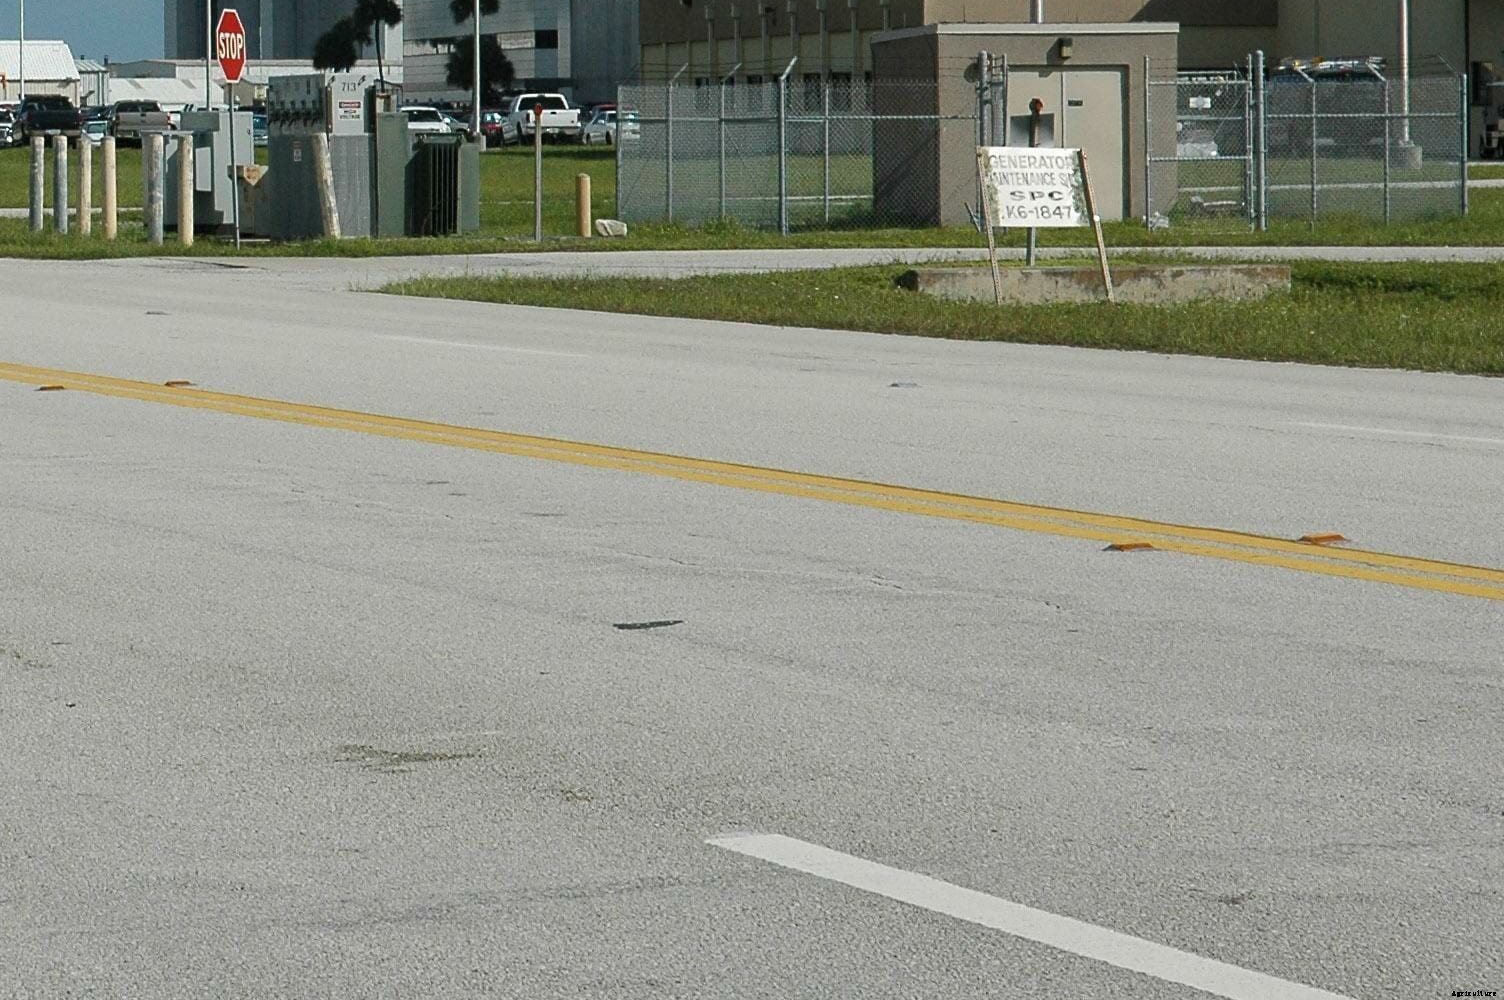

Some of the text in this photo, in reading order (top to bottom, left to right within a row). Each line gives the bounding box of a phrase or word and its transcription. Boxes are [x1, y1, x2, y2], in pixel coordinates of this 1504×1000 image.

[219, 32, 243, 60] STOP
[341, 81, 356, 92] 713
[988, 154, 1074, 169] GENERATOR
[1009, 190, 1064, 201] SPC
